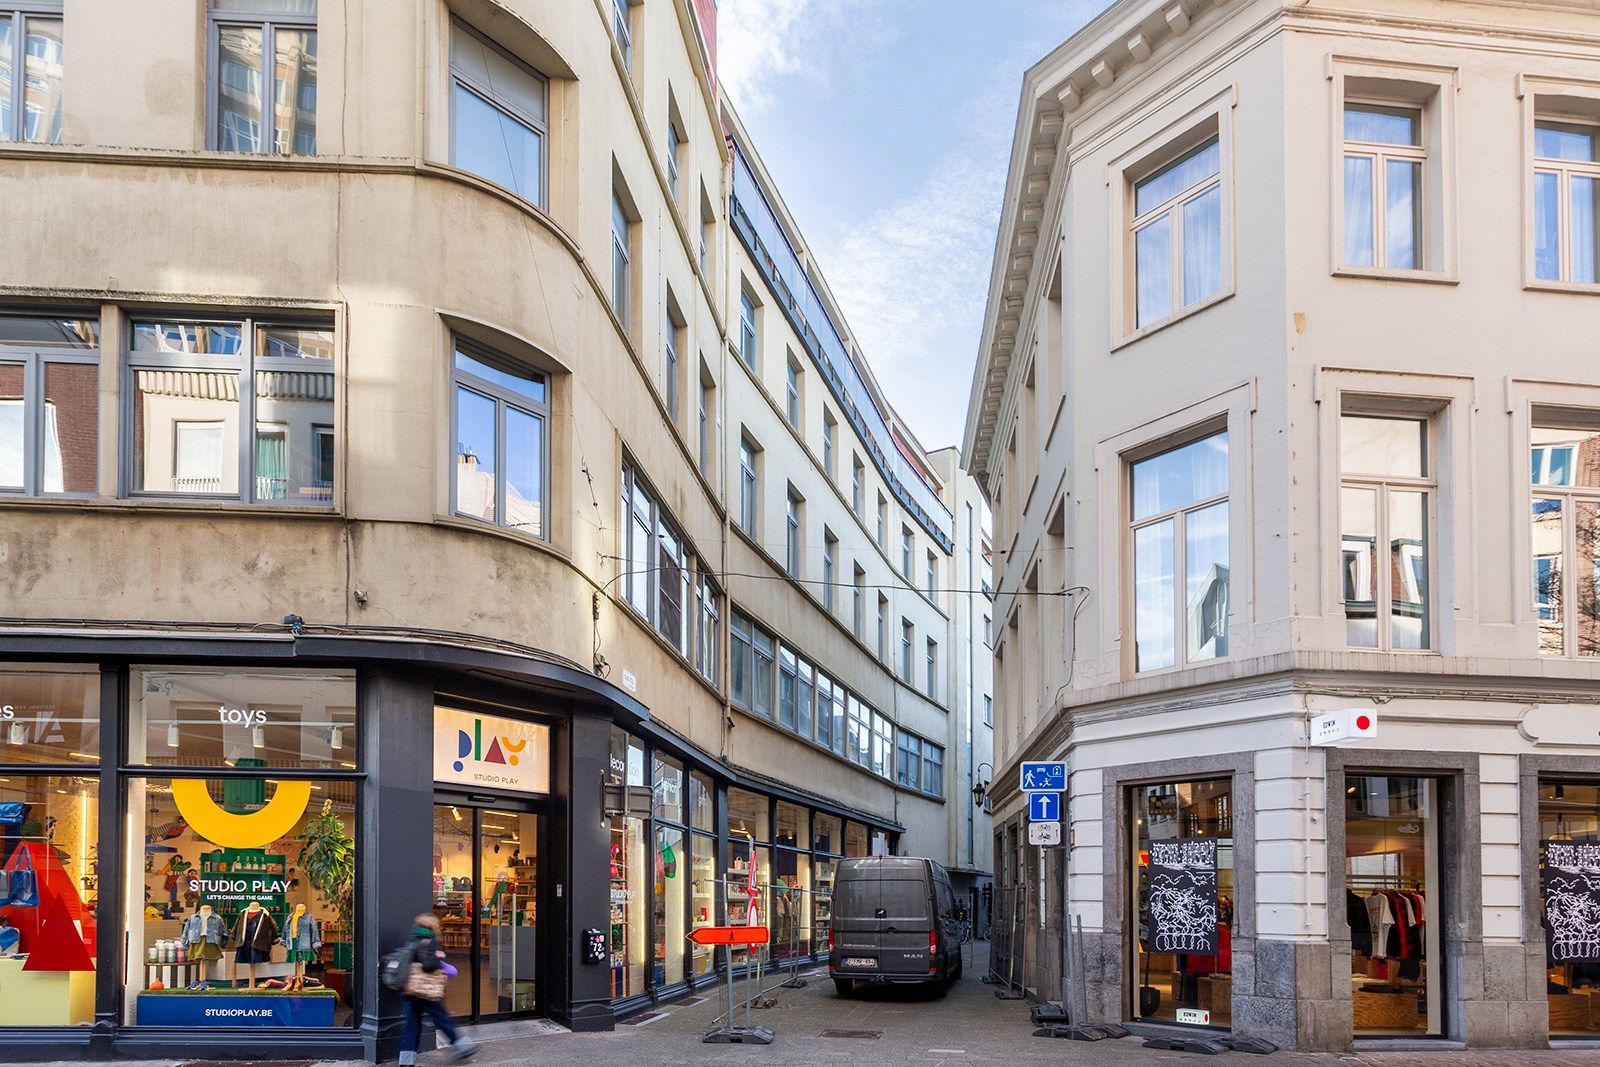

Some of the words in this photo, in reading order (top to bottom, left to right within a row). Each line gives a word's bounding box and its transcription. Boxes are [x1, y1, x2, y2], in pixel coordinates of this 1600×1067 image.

[0, 704, 15, 720] s
[218, 705, 267, 728] toys
[473, 773, 500, 783] STUDIO
[501, 777, 519, 785] PLAY
[189, 879, 247, 892] STUDIO
[252, 880, 291, 893] PLAY
[593, 943, 603, 952] 72
[205, 1008, 273, 1017] STUDIOPLAY.BE
